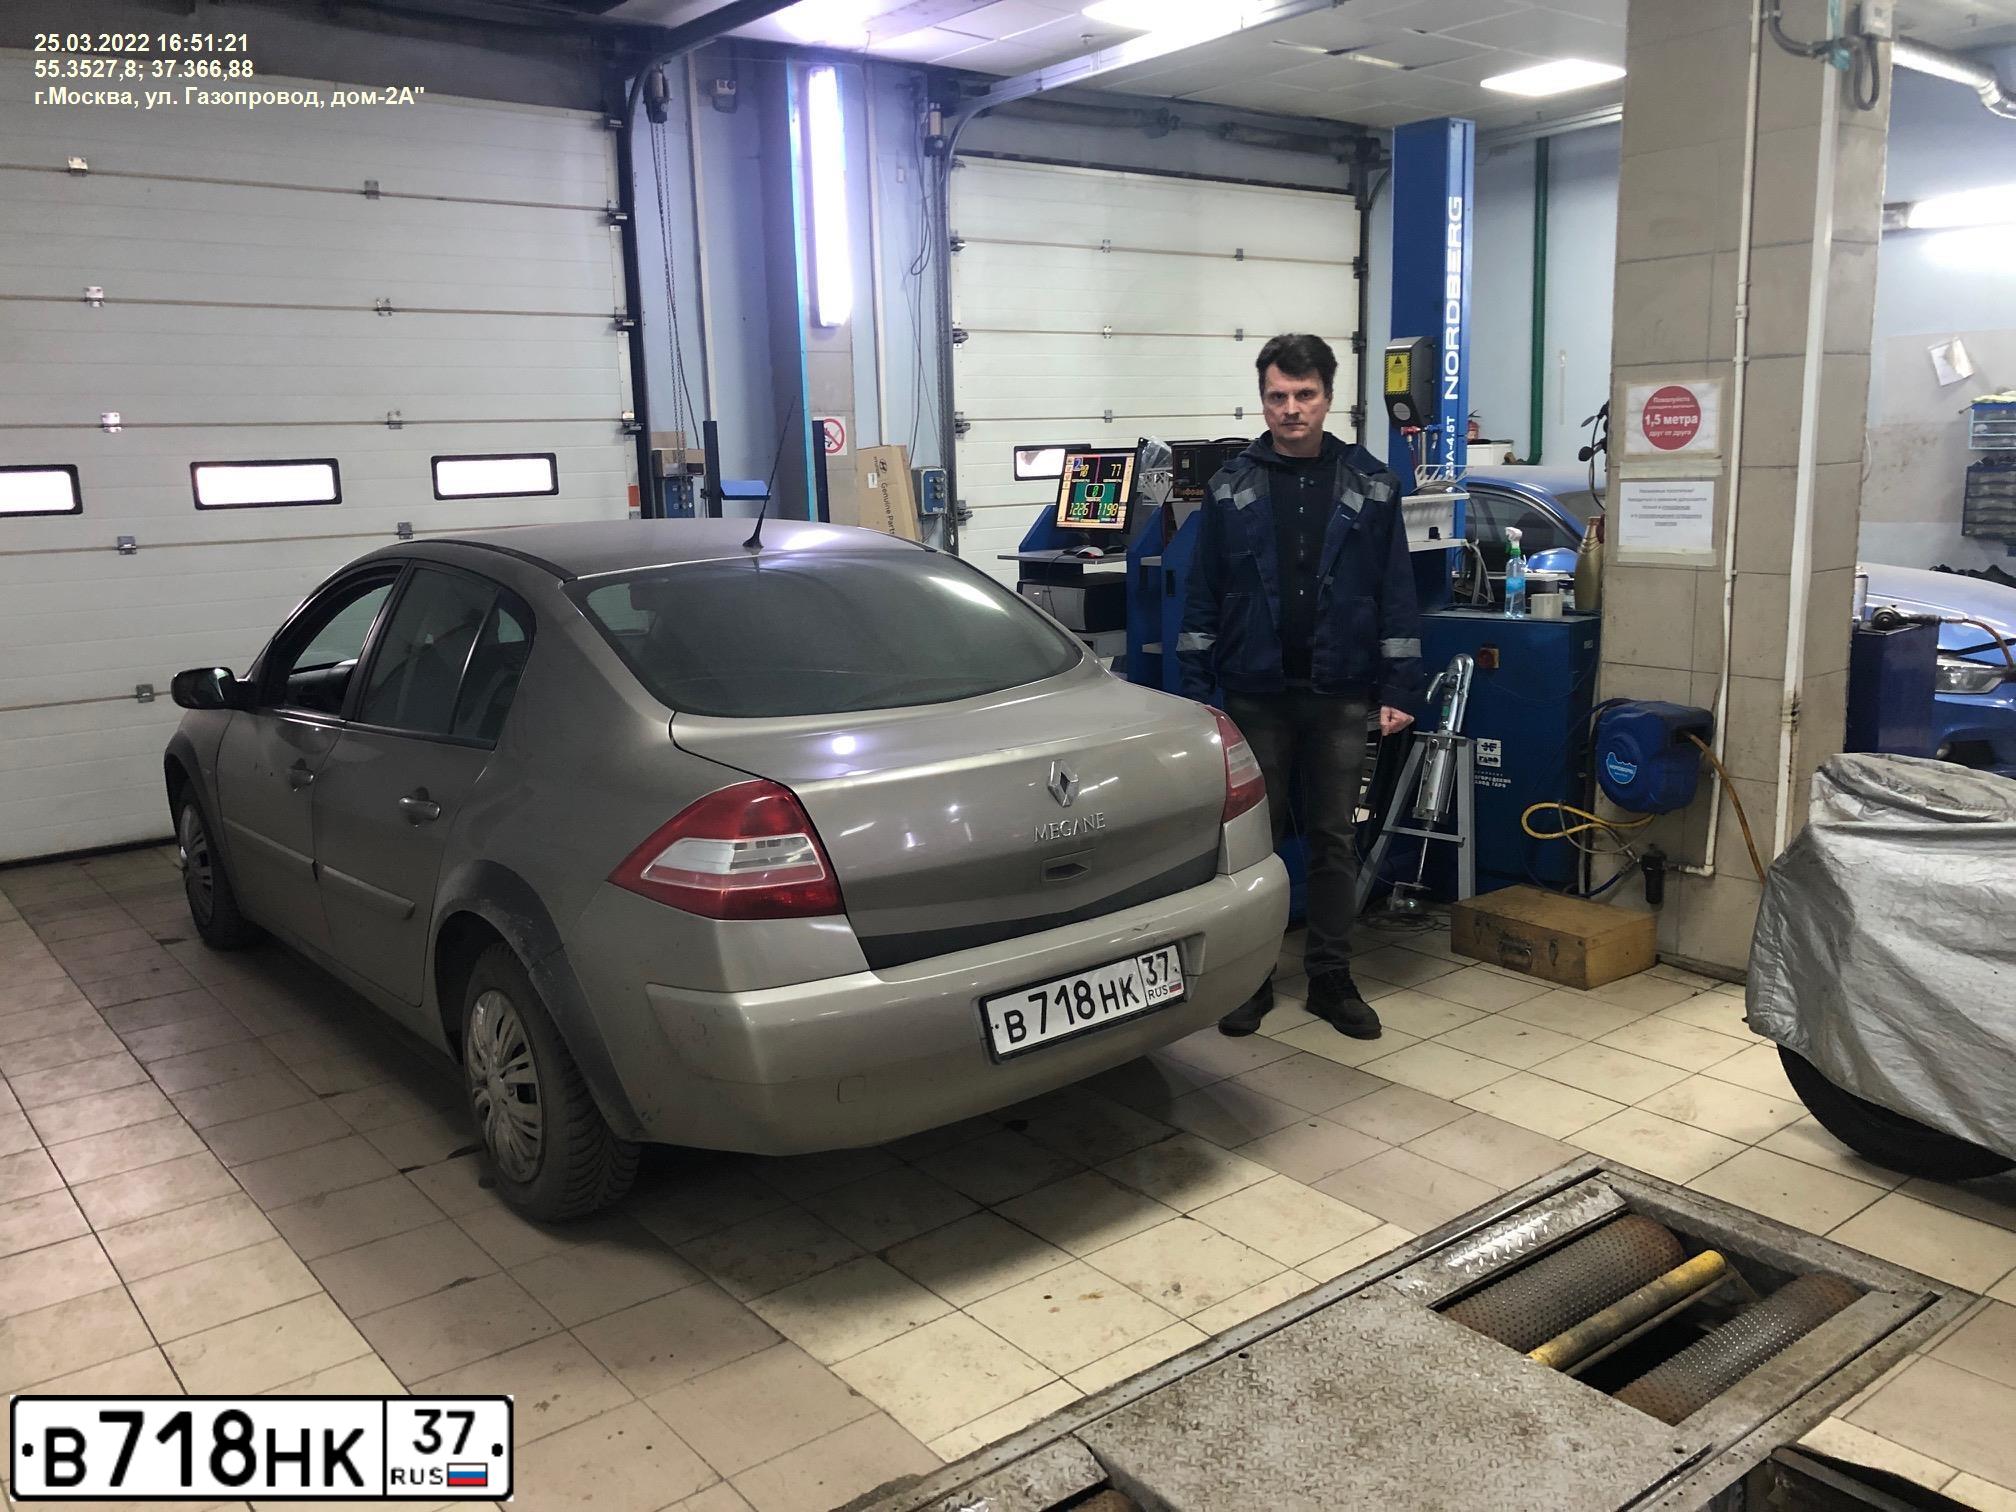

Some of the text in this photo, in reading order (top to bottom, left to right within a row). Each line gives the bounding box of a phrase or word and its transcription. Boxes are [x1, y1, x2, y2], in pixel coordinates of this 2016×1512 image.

[1444, 196, 1462, 400] NORDBERG
[1645, 413, 1698, 427] 1,5 метра
[1110, 463, 1122, 477] 77
[880, 482, 891, 515] Genuine
[1069, 502, 1119, 516] 1226 1198
[1034, 812, 1106, 842] MEGANE
[1141, 950, 1169, 986] 37
[1148, 984, 1169, 1000] RUS
